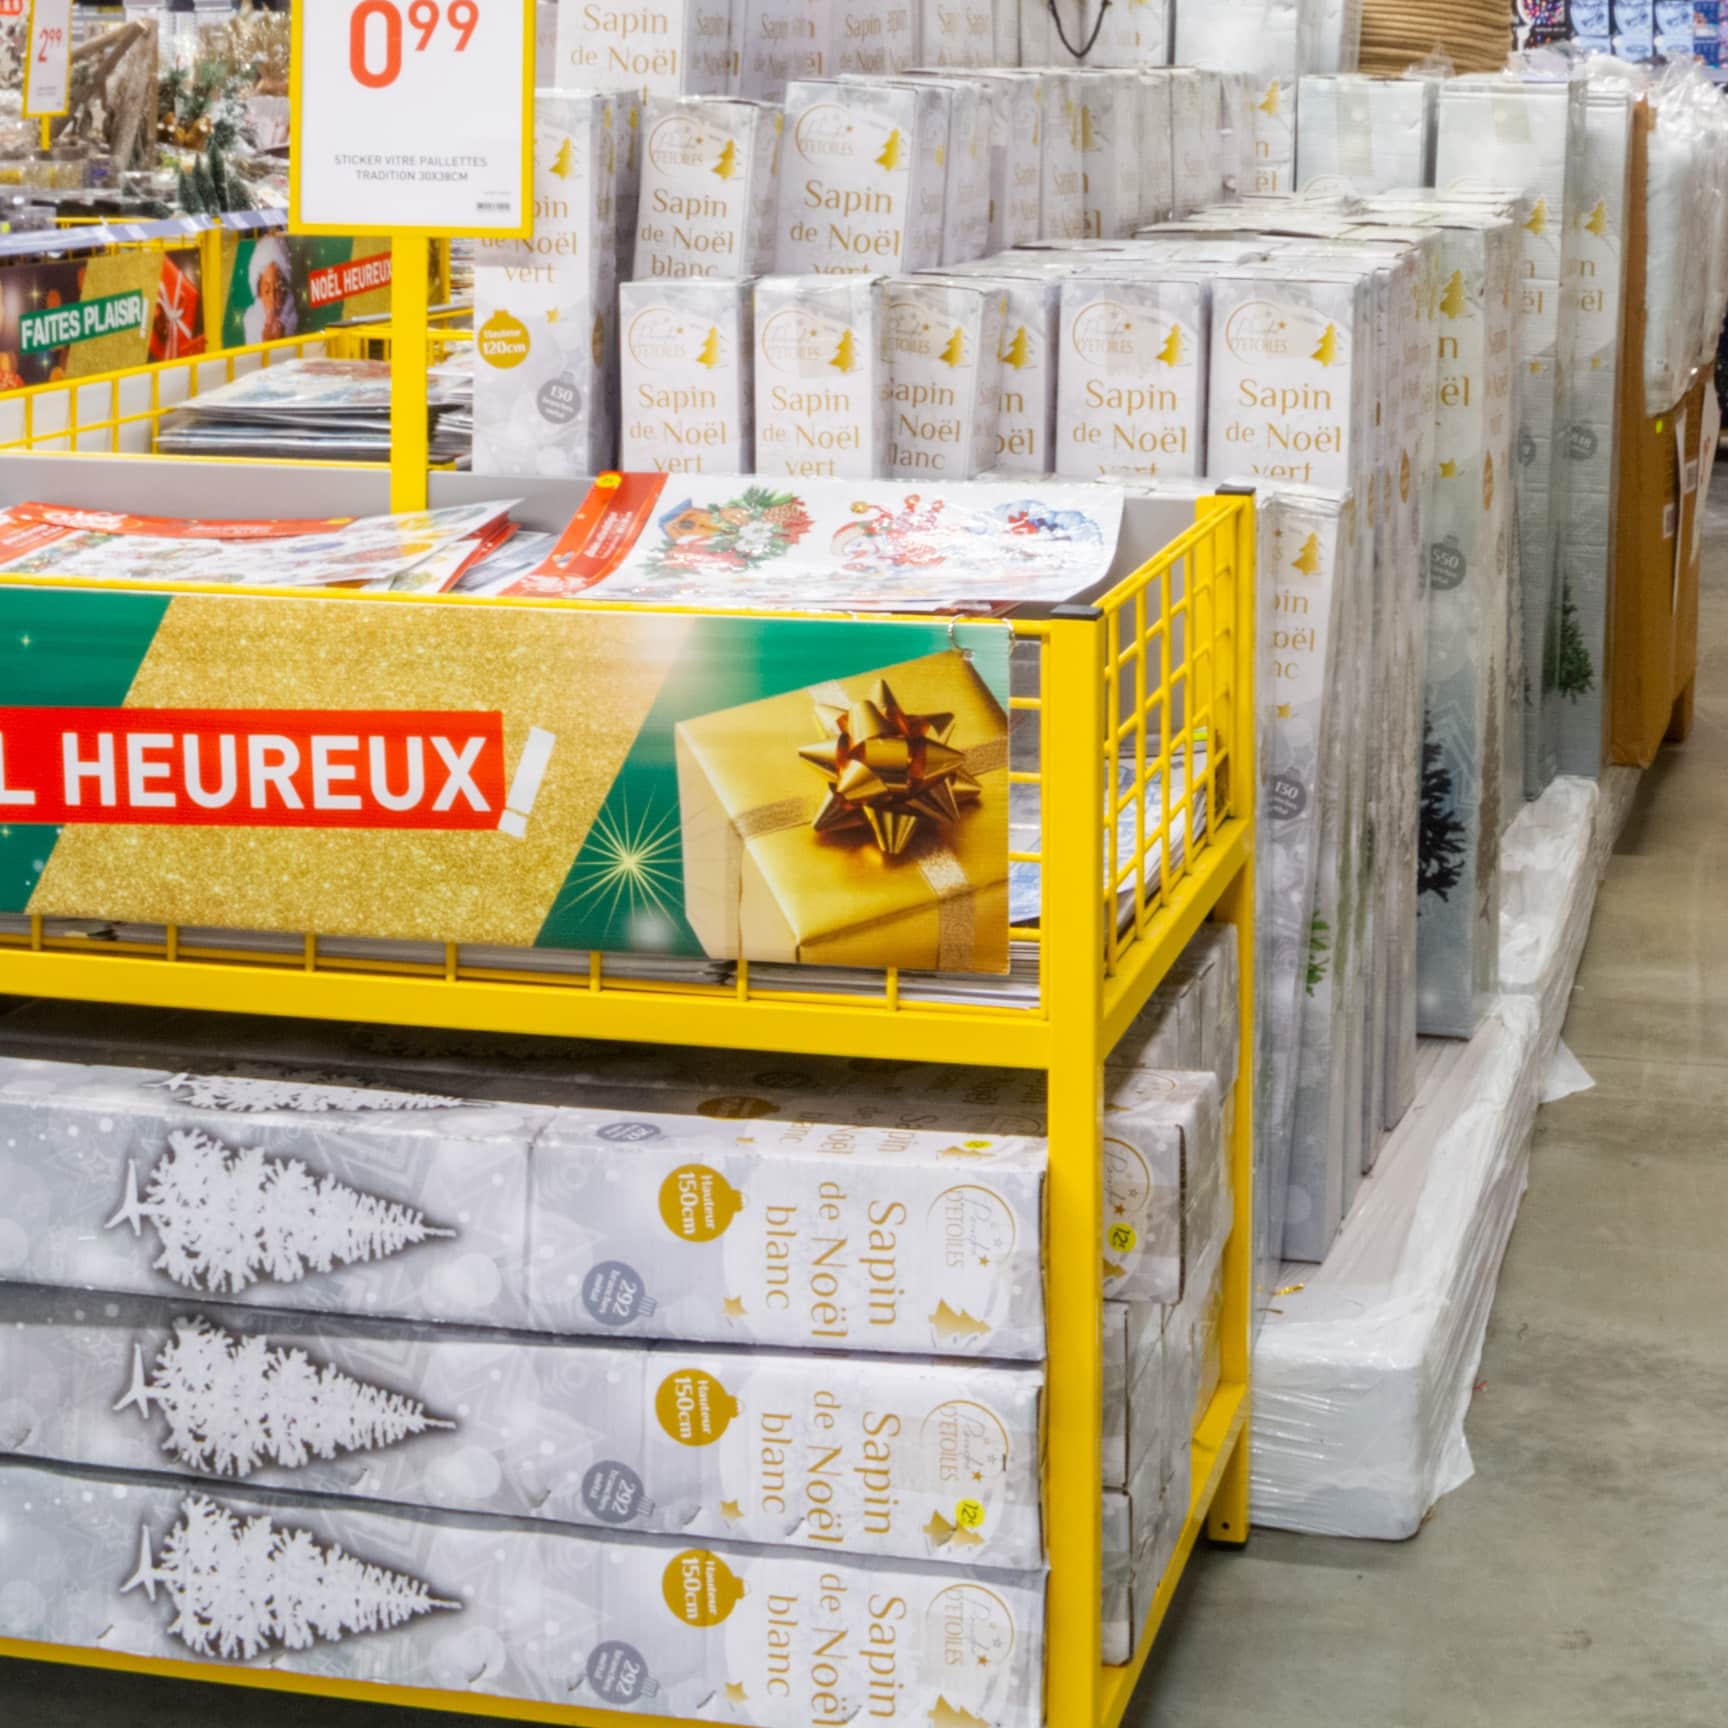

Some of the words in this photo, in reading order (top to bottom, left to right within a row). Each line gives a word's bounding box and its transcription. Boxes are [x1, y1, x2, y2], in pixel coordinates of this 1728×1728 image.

[583, 2, 669, 40] Sapin
[571, 46, 599, 66] de
[608, 46, 678, 76] Noël
[333, 154, 382, 166] STICKER
[384, 154, 416, 166] VITRE
[419, 155, 488, 168] PAILLETTES
[355, 169, 416, 182] TRADITION
[652, 187, 728, 221] Sapin
[804, 178, 895, 217] Sapin
[516, 232, 578, 257] Noël
[641, 224, 664, 242] de
[673, 226, 735, 255] Noël
[790, 222, 818, 243] de
[829, 223, 902, 258] Noël
[503, 262, 555, 284] vert
[652, 253, 719, 278] blanc
[309, 271, 342, 305] NOËL
[20, 309, 81, 351] FAITES
[483, 340, 526, 356] 120cm
[638, 383, 717, 415] Sapin
[771, 385, 850, 416] Sapin
[1086, 378, 1177, 417] Sapin
[1239, 377, 1332, 416] Sapin
[629, 421, 655, 440] de
[662, 420, 728, 446] Noël
[762, 424, 788, 443] de
[796, 423, 861, 449] Noël
[898, 413, 962, 444] Noël
[1072, 421, 1101, 443] de
[1113, 423, 1188, 454] Noël
[1225, 421, 1255, 442] de
[1266, 421, 1343, 454] Noël
[652, 454, 704, 473] vert
[784, 458, 836, 477] vert
[675, 1170, 697, 1235] 150cm
[701, 1174, 716, 1230] Hauteur
[818, 1180, 848, 1222] de
[765, 1204, 798, 1310] blanc
[859, 1199, 907, 1327] Sapin
[612, 1278, 637, 1318] 292
[810, 1236, 849, 1338] Noël
[673, 1375, 695, 1440] 150cm
[697, 1379, 713, 1435] Hauteur
[812, 1389, 843, 1431] de
[760, 1411, 793, 1514] blanc
[853, 1410, 902, 1535] Sapin
[612, 1477, 637, 1516] 292
[806, 1444, 845, 1544] Noël
[678, 1555, 700, 1620] 150cm
[703, 1559, 718, 1617] Hauteur
[818, 1572, 849, 1614] de
[766, 1593, 799, 1697] blanc
[859, 1593, 907, 1719] Sapin
[616, 1662, 641, 1698] 292
[810, 1626, 850, 1728] Noël
